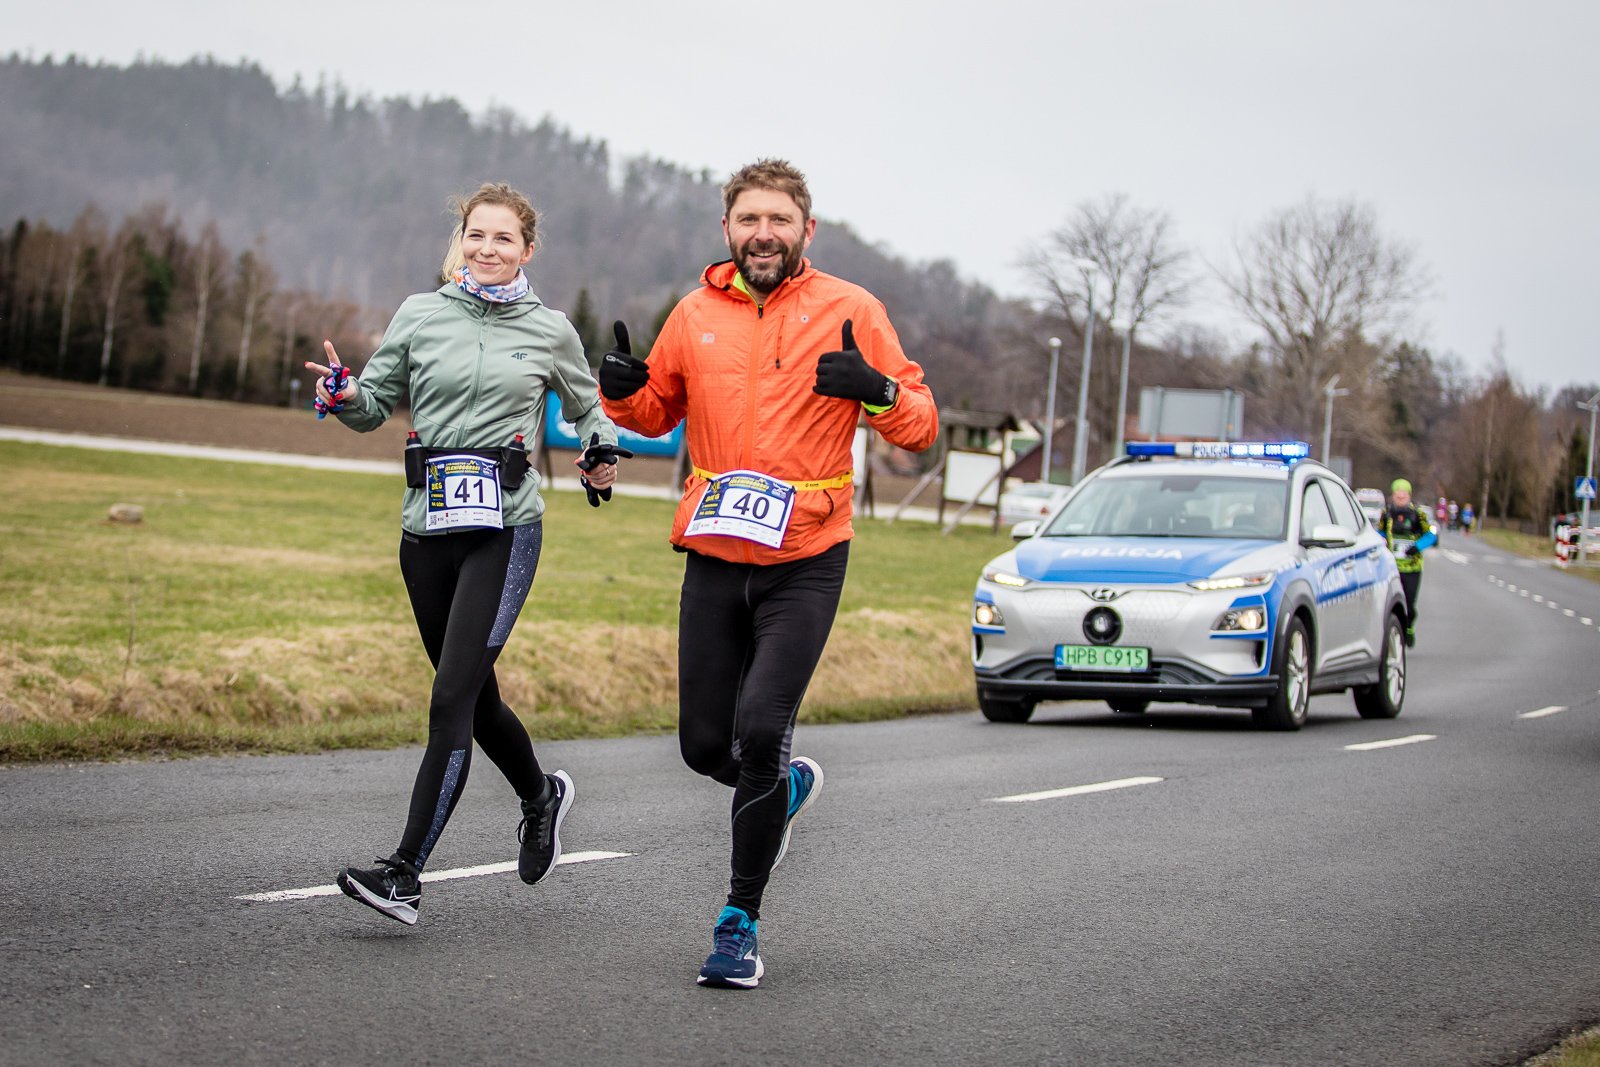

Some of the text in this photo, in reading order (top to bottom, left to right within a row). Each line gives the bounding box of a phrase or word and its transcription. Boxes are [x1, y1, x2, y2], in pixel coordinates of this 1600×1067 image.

[511, 352, 528, 360] 4F
[1193, 445, 1229, 456] POLICJA
[454, 478, 484, 503] 41
[733, 493, 770, 519] 40
[1060, 547, 1182, 560] POLICJA
[1066, 648, 1144, 667] HPB C915
